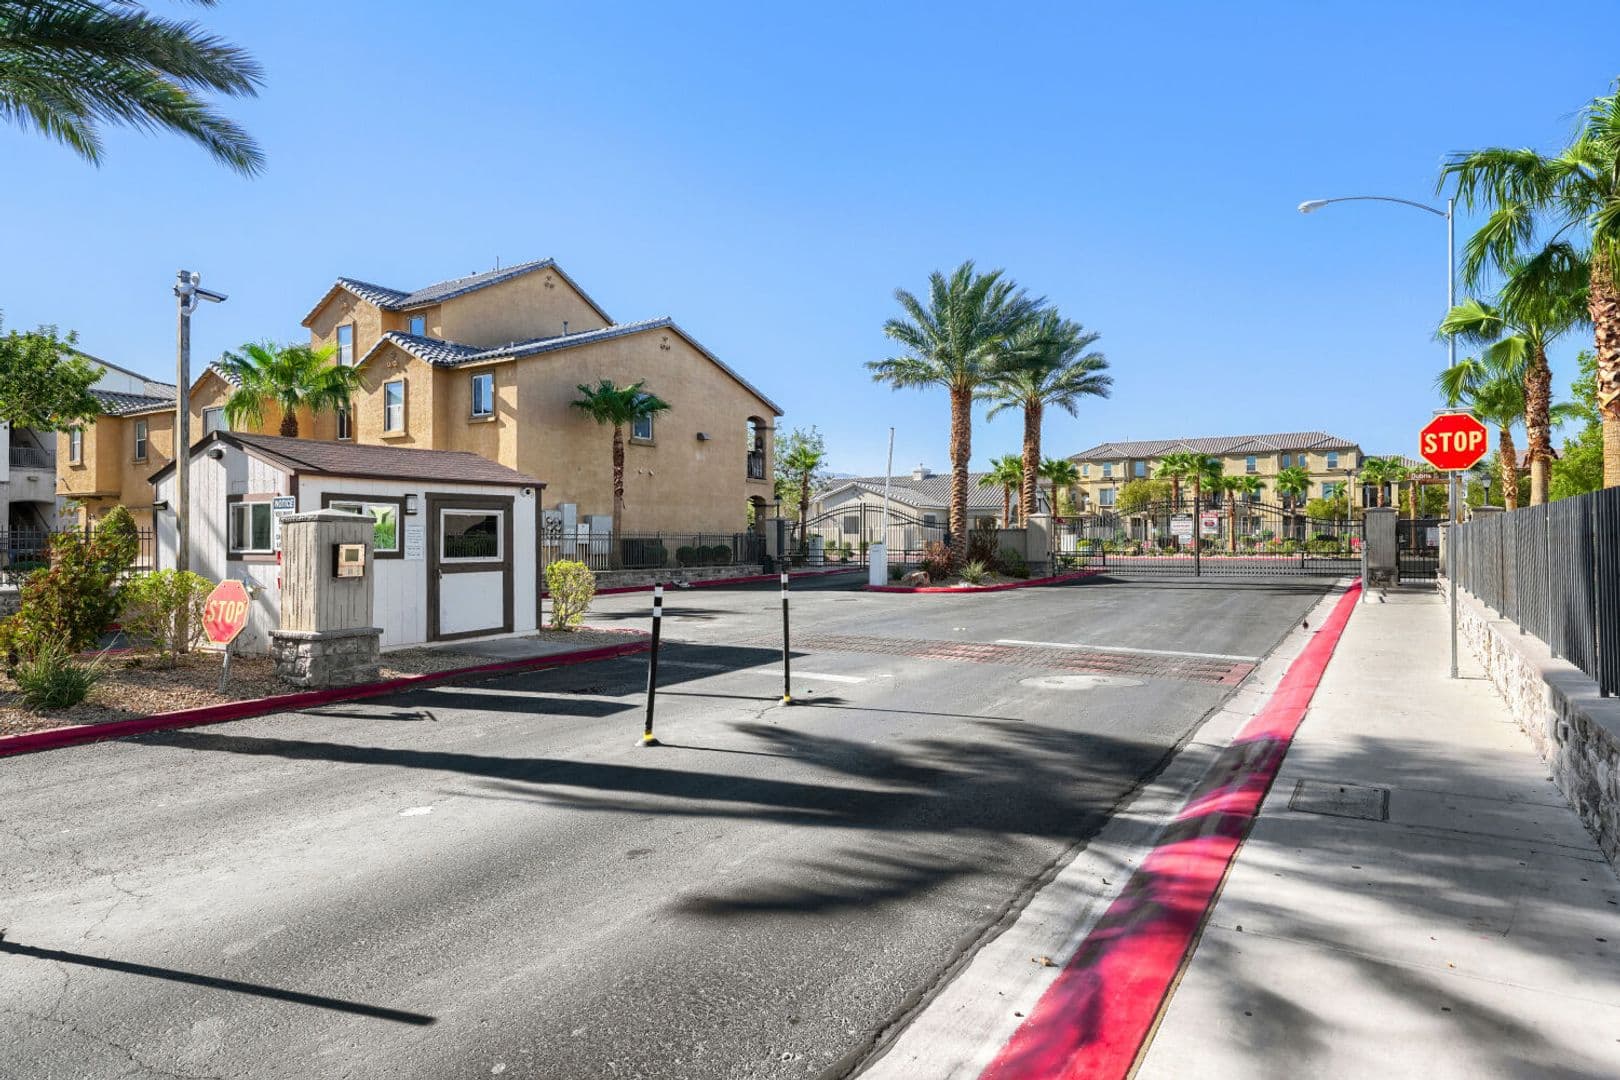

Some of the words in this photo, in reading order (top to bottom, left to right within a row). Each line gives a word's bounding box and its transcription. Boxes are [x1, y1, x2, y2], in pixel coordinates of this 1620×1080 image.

[1424, 431, 1482, 454] STOP
[274, 499, 294, 508] NOTICE
[207, 600, 244, 623] STOP
